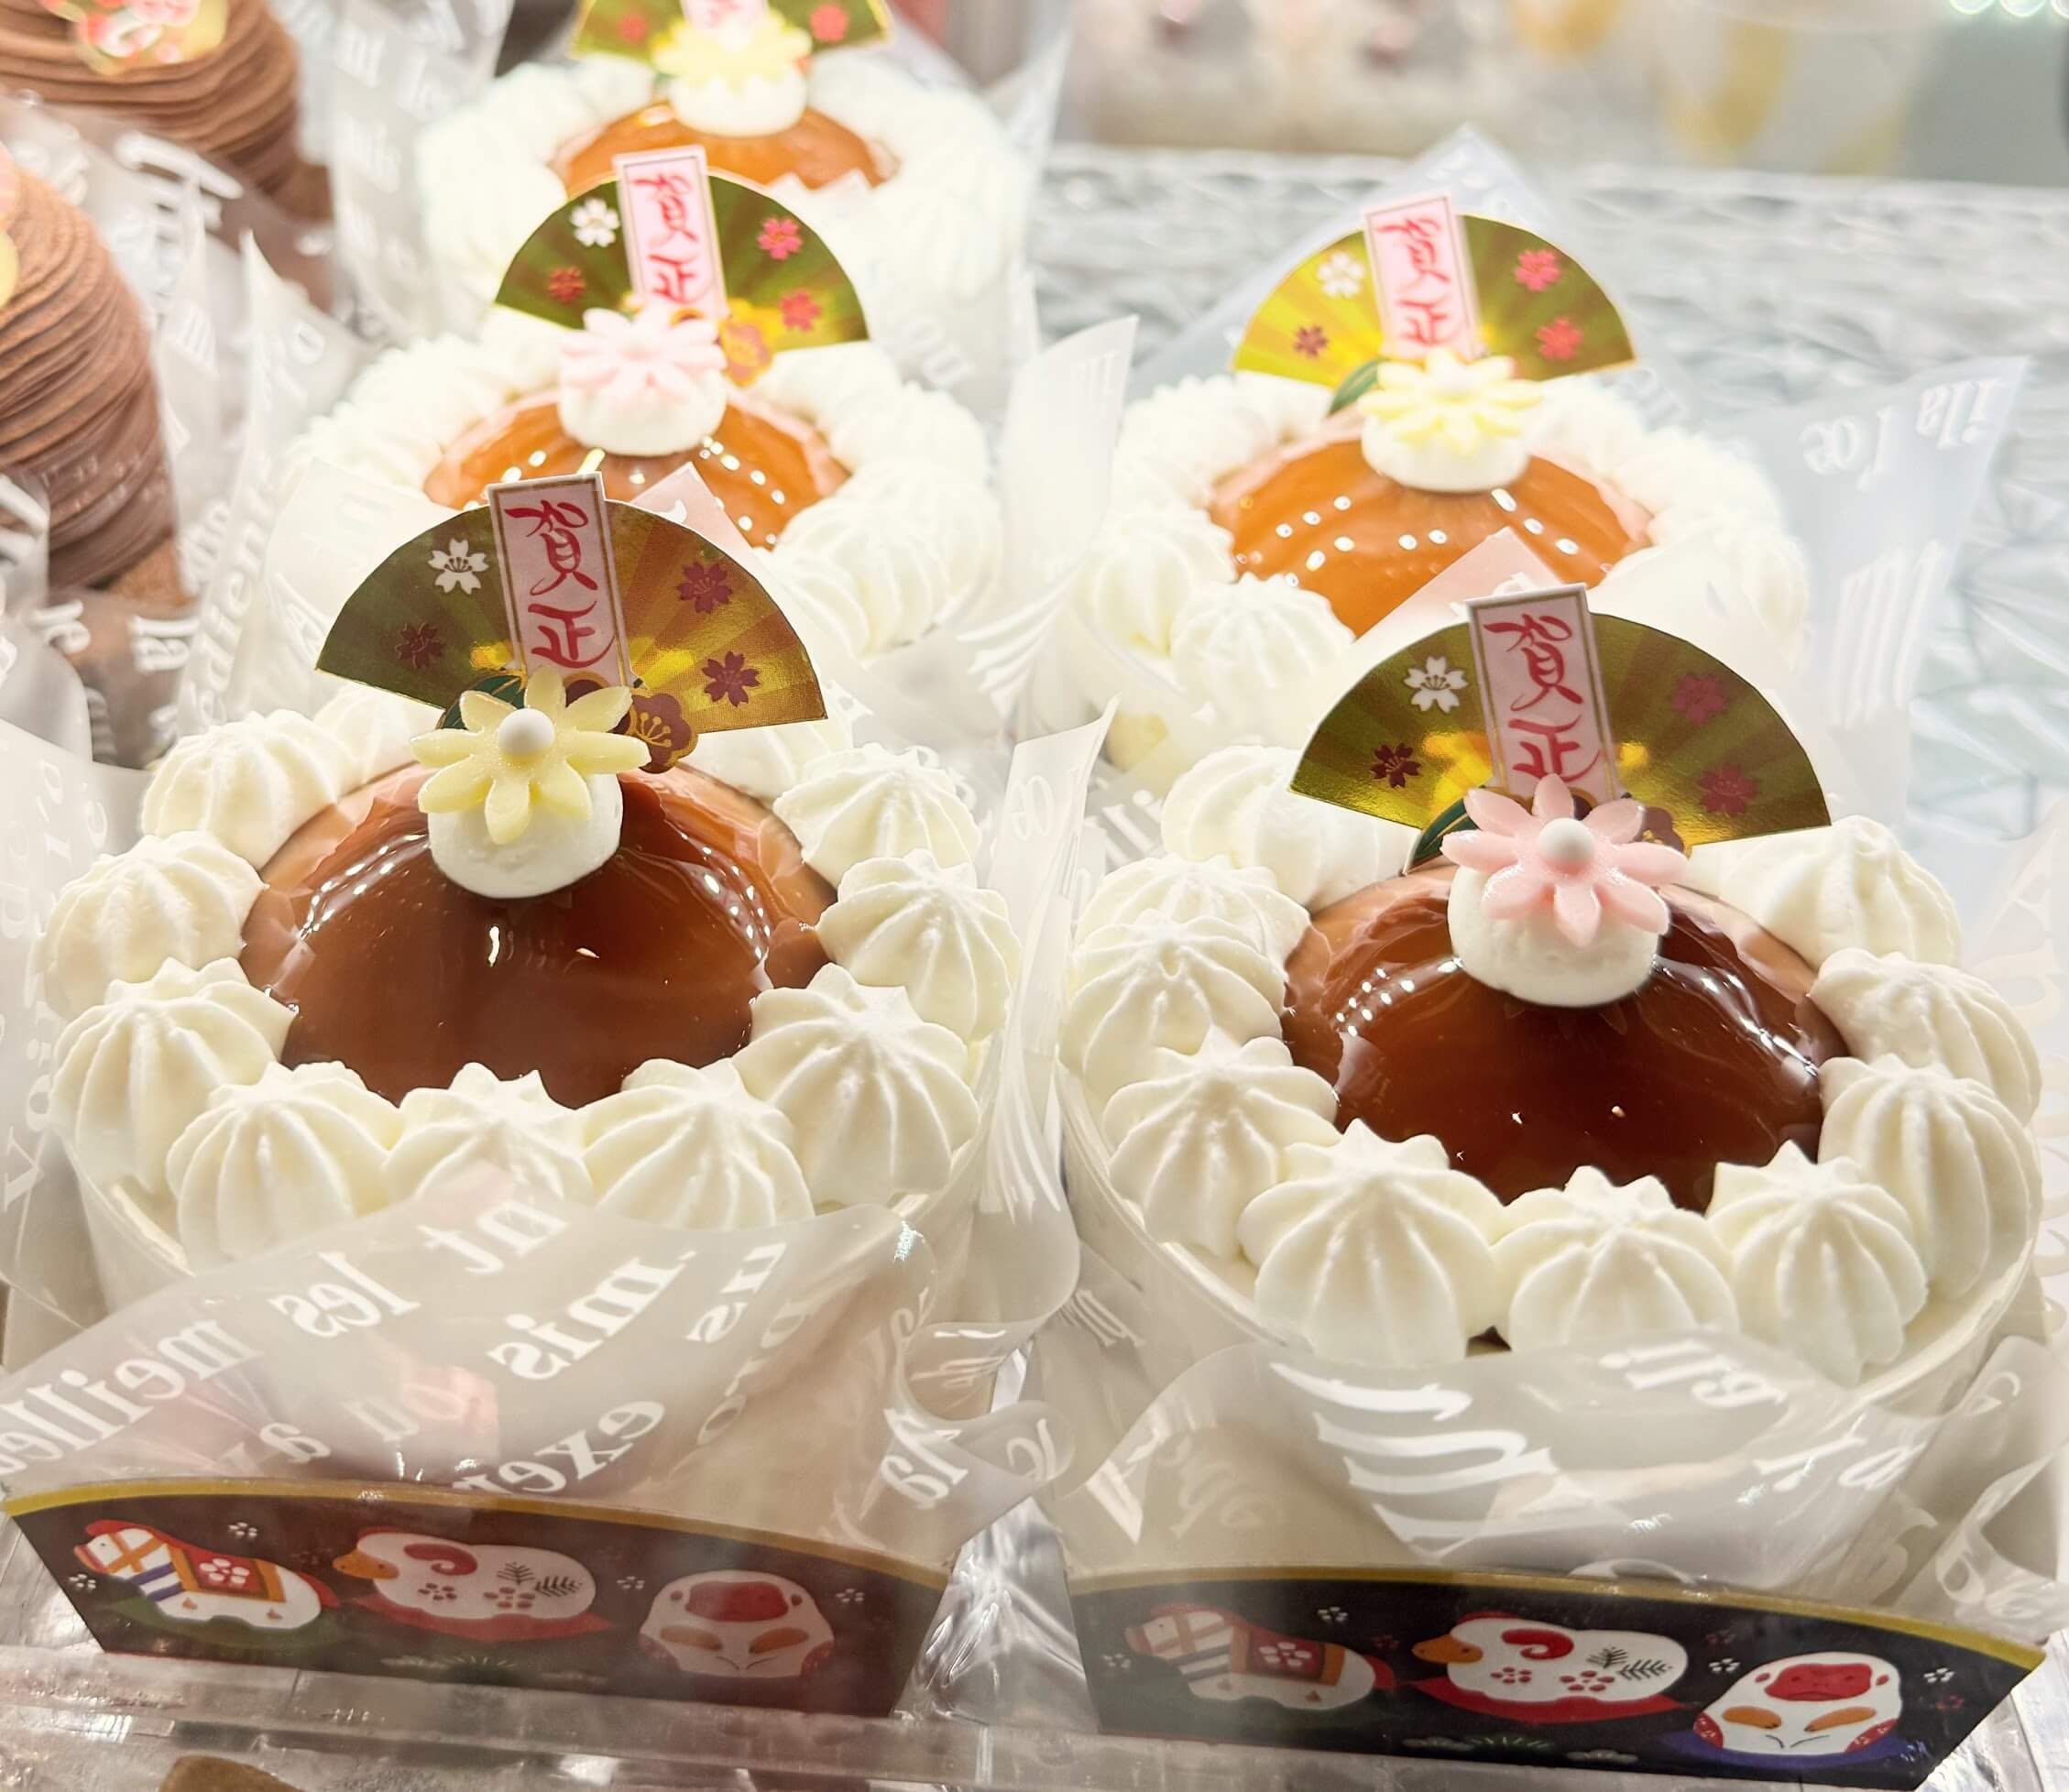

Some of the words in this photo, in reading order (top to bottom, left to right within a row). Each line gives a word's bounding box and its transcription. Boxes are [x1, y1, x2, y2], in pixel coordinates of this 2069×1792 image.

[630, 173, 713, 305] 賀正
[1377, 218, 1463, 346] 賀正
[504, 499, 616, 669] 賀正
[1483, 613, 1601, 783] 賀正
